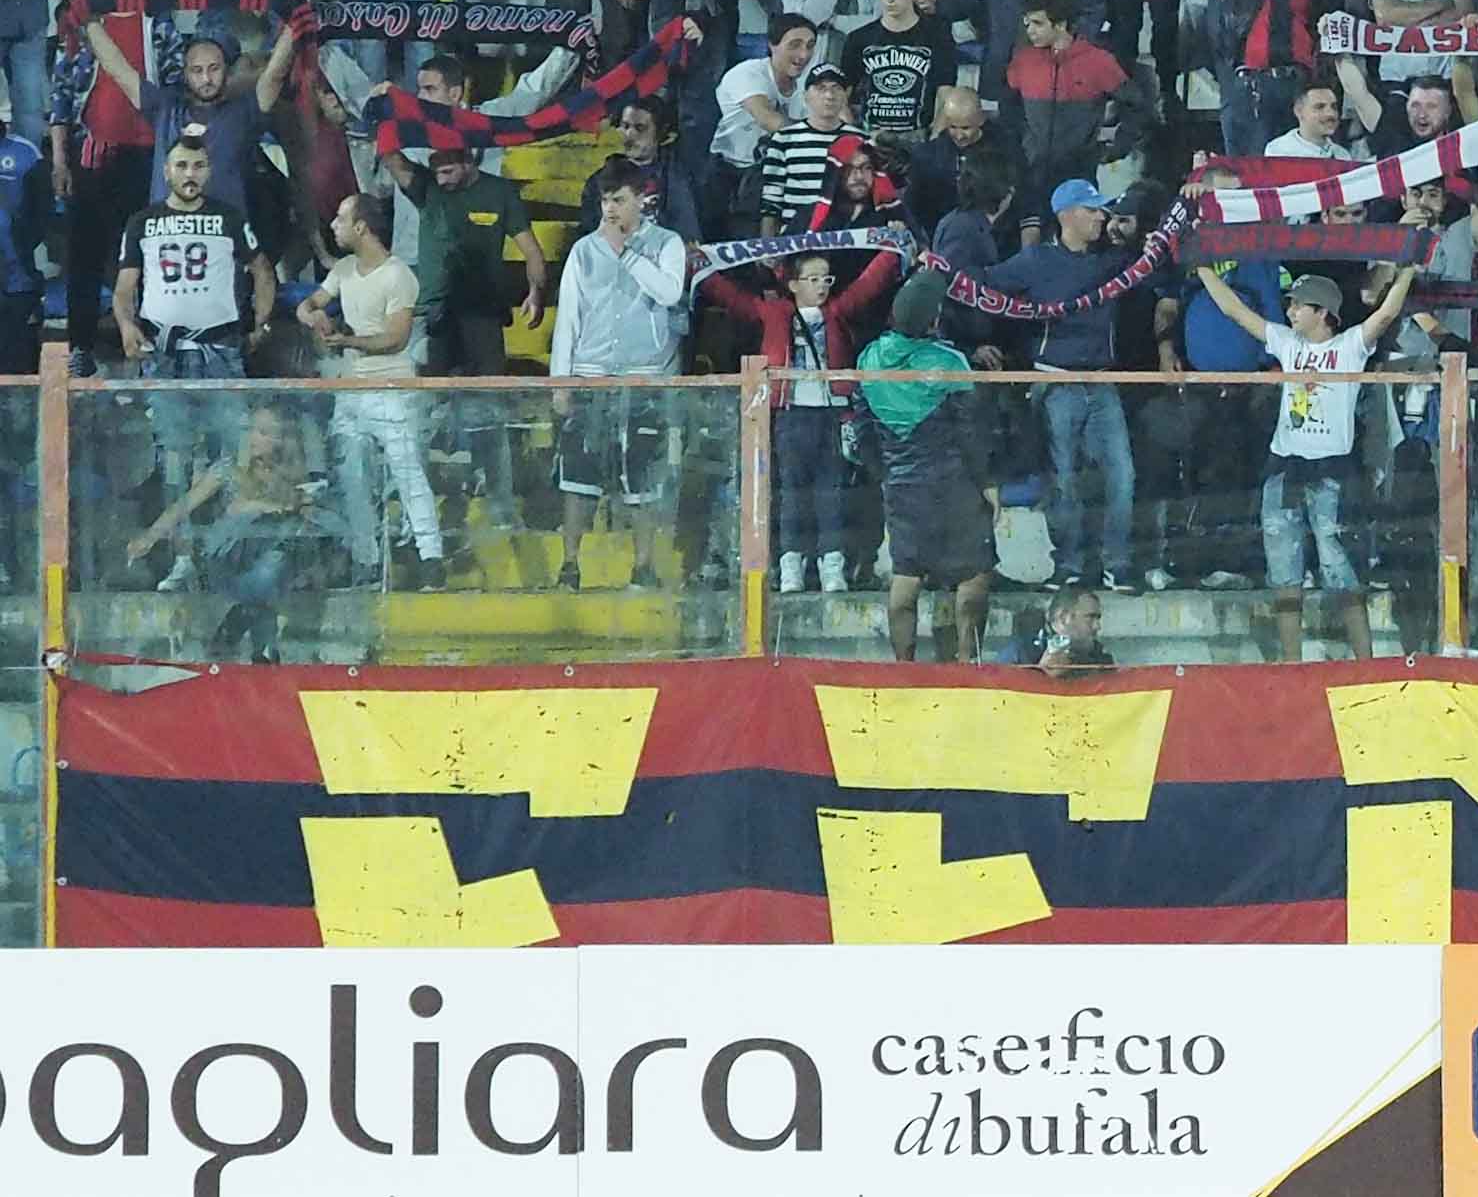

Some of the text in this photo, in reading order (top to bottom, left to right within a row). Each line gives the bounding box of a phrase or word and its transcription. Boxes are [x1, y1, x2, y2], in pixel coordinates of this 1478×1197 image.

[863, 53, 889, 75] JACK
[145, 215, 223, 237] GANGSTER
[159, 242, 208, 283] 68
[717, 232, 854, 264] CASERTANA
[0, 985, 823, 1197] agliara
